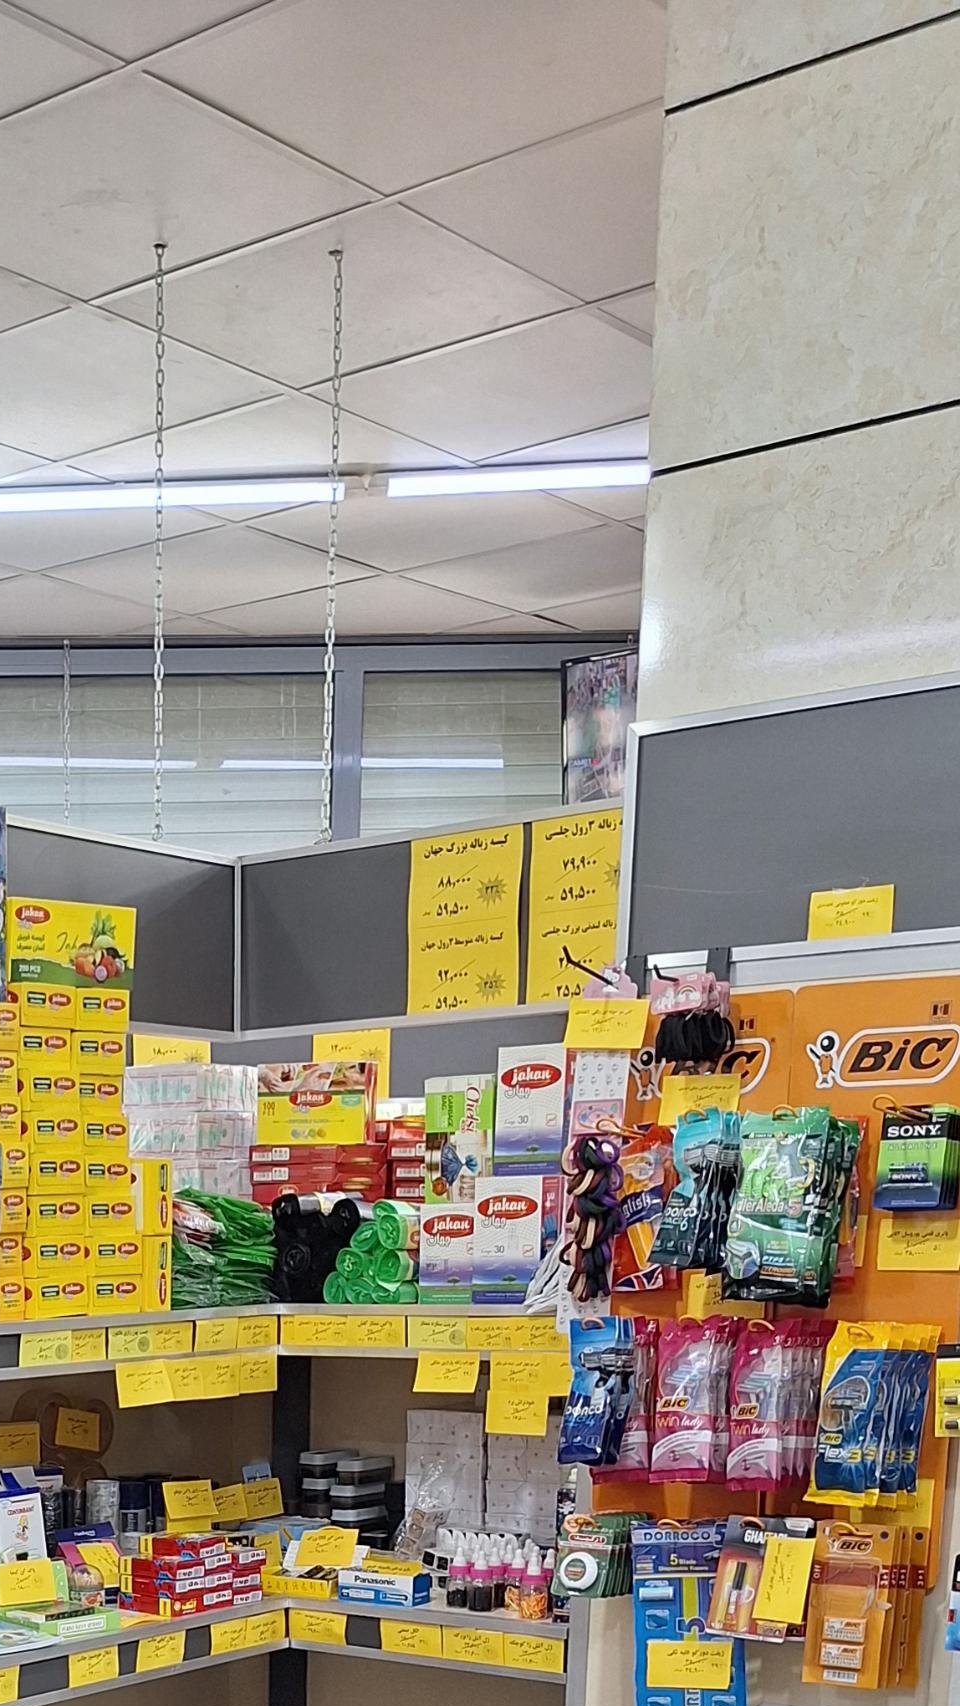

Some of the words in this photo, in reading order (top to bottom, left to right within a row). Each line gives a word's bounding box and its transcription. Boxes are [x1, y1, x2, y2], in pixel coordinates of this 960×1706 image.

[510, 1067, 552, 1086] jahan
[887, 1124, 941, 1139] SONY
[487, 1198, 527, 1214] jahan
[655, 1415, 680, 1428] Twin
[681, 1415, 703, 1430] lady
[751, 1423, 771, 1437] lady
[644, 1530, 711, 1543] DORROCO
[669, 1554, 677, 1565] 5
[354, 1575, 396, 1586] Panasonic
